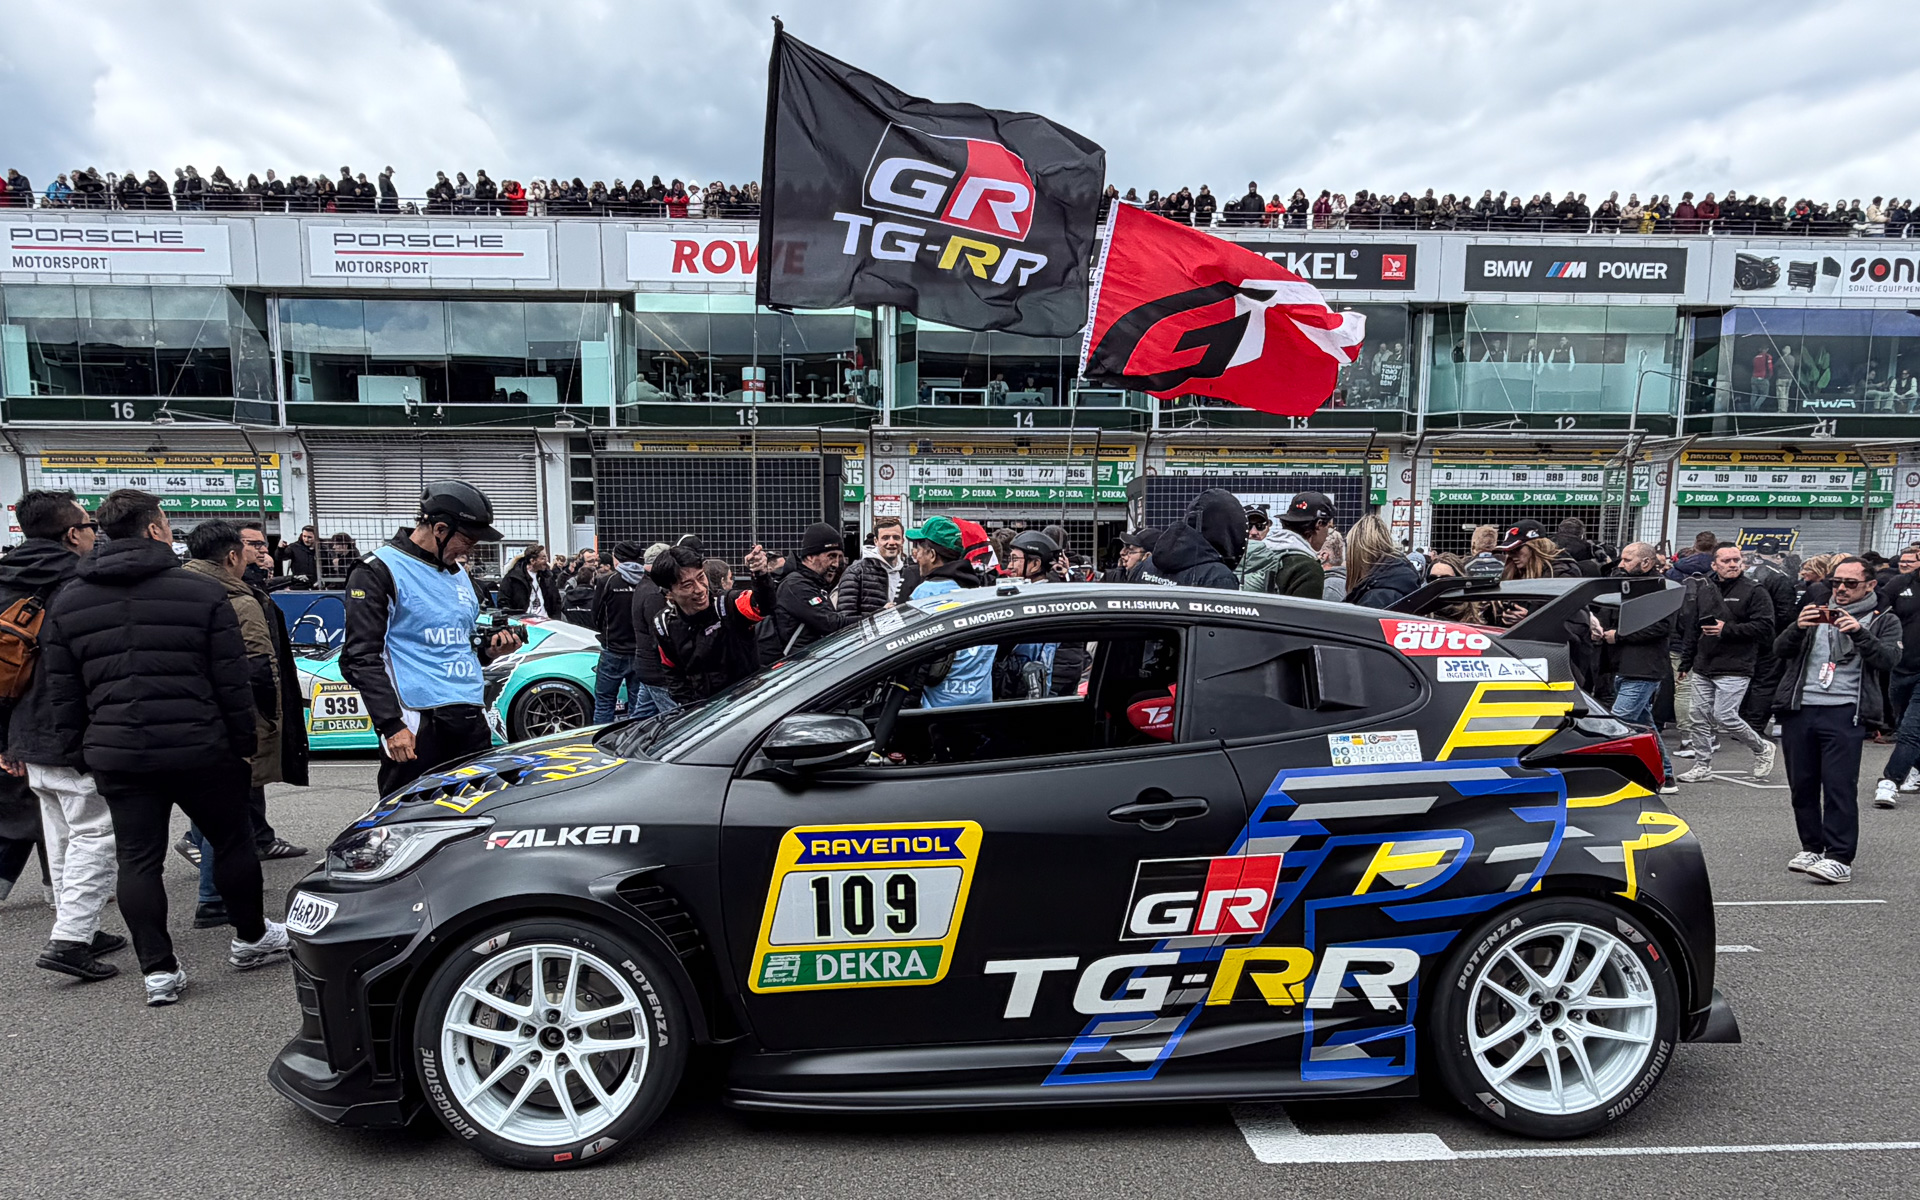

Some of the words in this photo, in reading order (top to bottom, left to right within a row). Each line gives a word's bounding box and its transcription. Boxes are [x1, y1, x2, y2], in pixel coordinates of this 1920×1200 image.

[869, 156, 1030, 234] GR
[10, 227, 184, 244] PORSCHE
[333, 233, 504, 248] PORSCHE
[12, 255, 108, 270] MOTORSPORT
[335, 261, 429, 274] MOTORSPORT
[1484, 260, 1532, 278] BMW
[1599, 262, 1668, 279] POWER
[110, 402, 135, 419] 16
[736, 409, 759, 426] 15
[1013, 412, 1034, 428] 14
[1287, 416, 1309, 430] 13
[1555, 417, 1576, 430] 12
[1039, 468, 1053, 478] 777
[1117, 462, 1134, 470] BOX
[1370, 464, 1387, 473] BOX
[1633, 466, 1650, 474] BOX
[93, 477, 106, 485] 99
[129, 477, 147, 486] 410
[166, 477, 186, 486] 445
[205, 477, 225, 487] 925
[1371, 474, 1386, 488] 13
[1632, 476, 1650, 489] 12
[1687, 474, 1699, 482] 47
[1744, 474, 1757, 483] 110
[1880, 477, 1893, 491] 11
[262, 479, 280, 494] 16
[929, 489, 953, 497] DEKRA
[972, 489, 996, 497] DEKRA
[1015, 489, 1040, 498] DEKRA
[1102, 490, 1126, 498] DEKRA
[201, 499, 227, 507] DEKRA
[1448, 493, 1472, 501] DEKRA
[1491, 493, 1515, 501] DEKRA
[1533, 493, 1557, 501] DEKRA
[1695, 494, 1719, 502] DEKRA
[1736, 494, 1760, 502] DEKRA
[1777, 495, 1801, 503] DEKRA
[1819, 495, 1843, 503] DEKRA
[1037, 601, 1097, 614] D.TOYODA
[1122, 600, 1180, 611] H.ISHIURA
[1203, 602, 1260, 617] K.OSHIMA
[968, 609, 1014, 625] MORIZO
[1396, 621, 1446, 633] sport
[897, 624, 945, 647] H.NARUSE
[1393, 631, 1492, 649] auto
[443, 661, 476, 677] 702
[324, 696, 358, 715] 939
[328, 718, 364, 730] DEKRA
[484, 825, 641, 850] FALKEN
[811, 836, 950, 855] RAVENOL
[809, 871, 918, 940] 109
[1129, 887, 1269, 935] GR
[1457, 917, 1523, 991] POTENZA
[816, 949, 928, 981] DEKRA
[983, 945, 1421, 1019] TG-RR
[621, 959, 668, 1047] POTENZA
[1607, 1039, 1671, 1121] BRIDGESTONE
[419, 1047, 479, 1141] BRIDGESTONE
